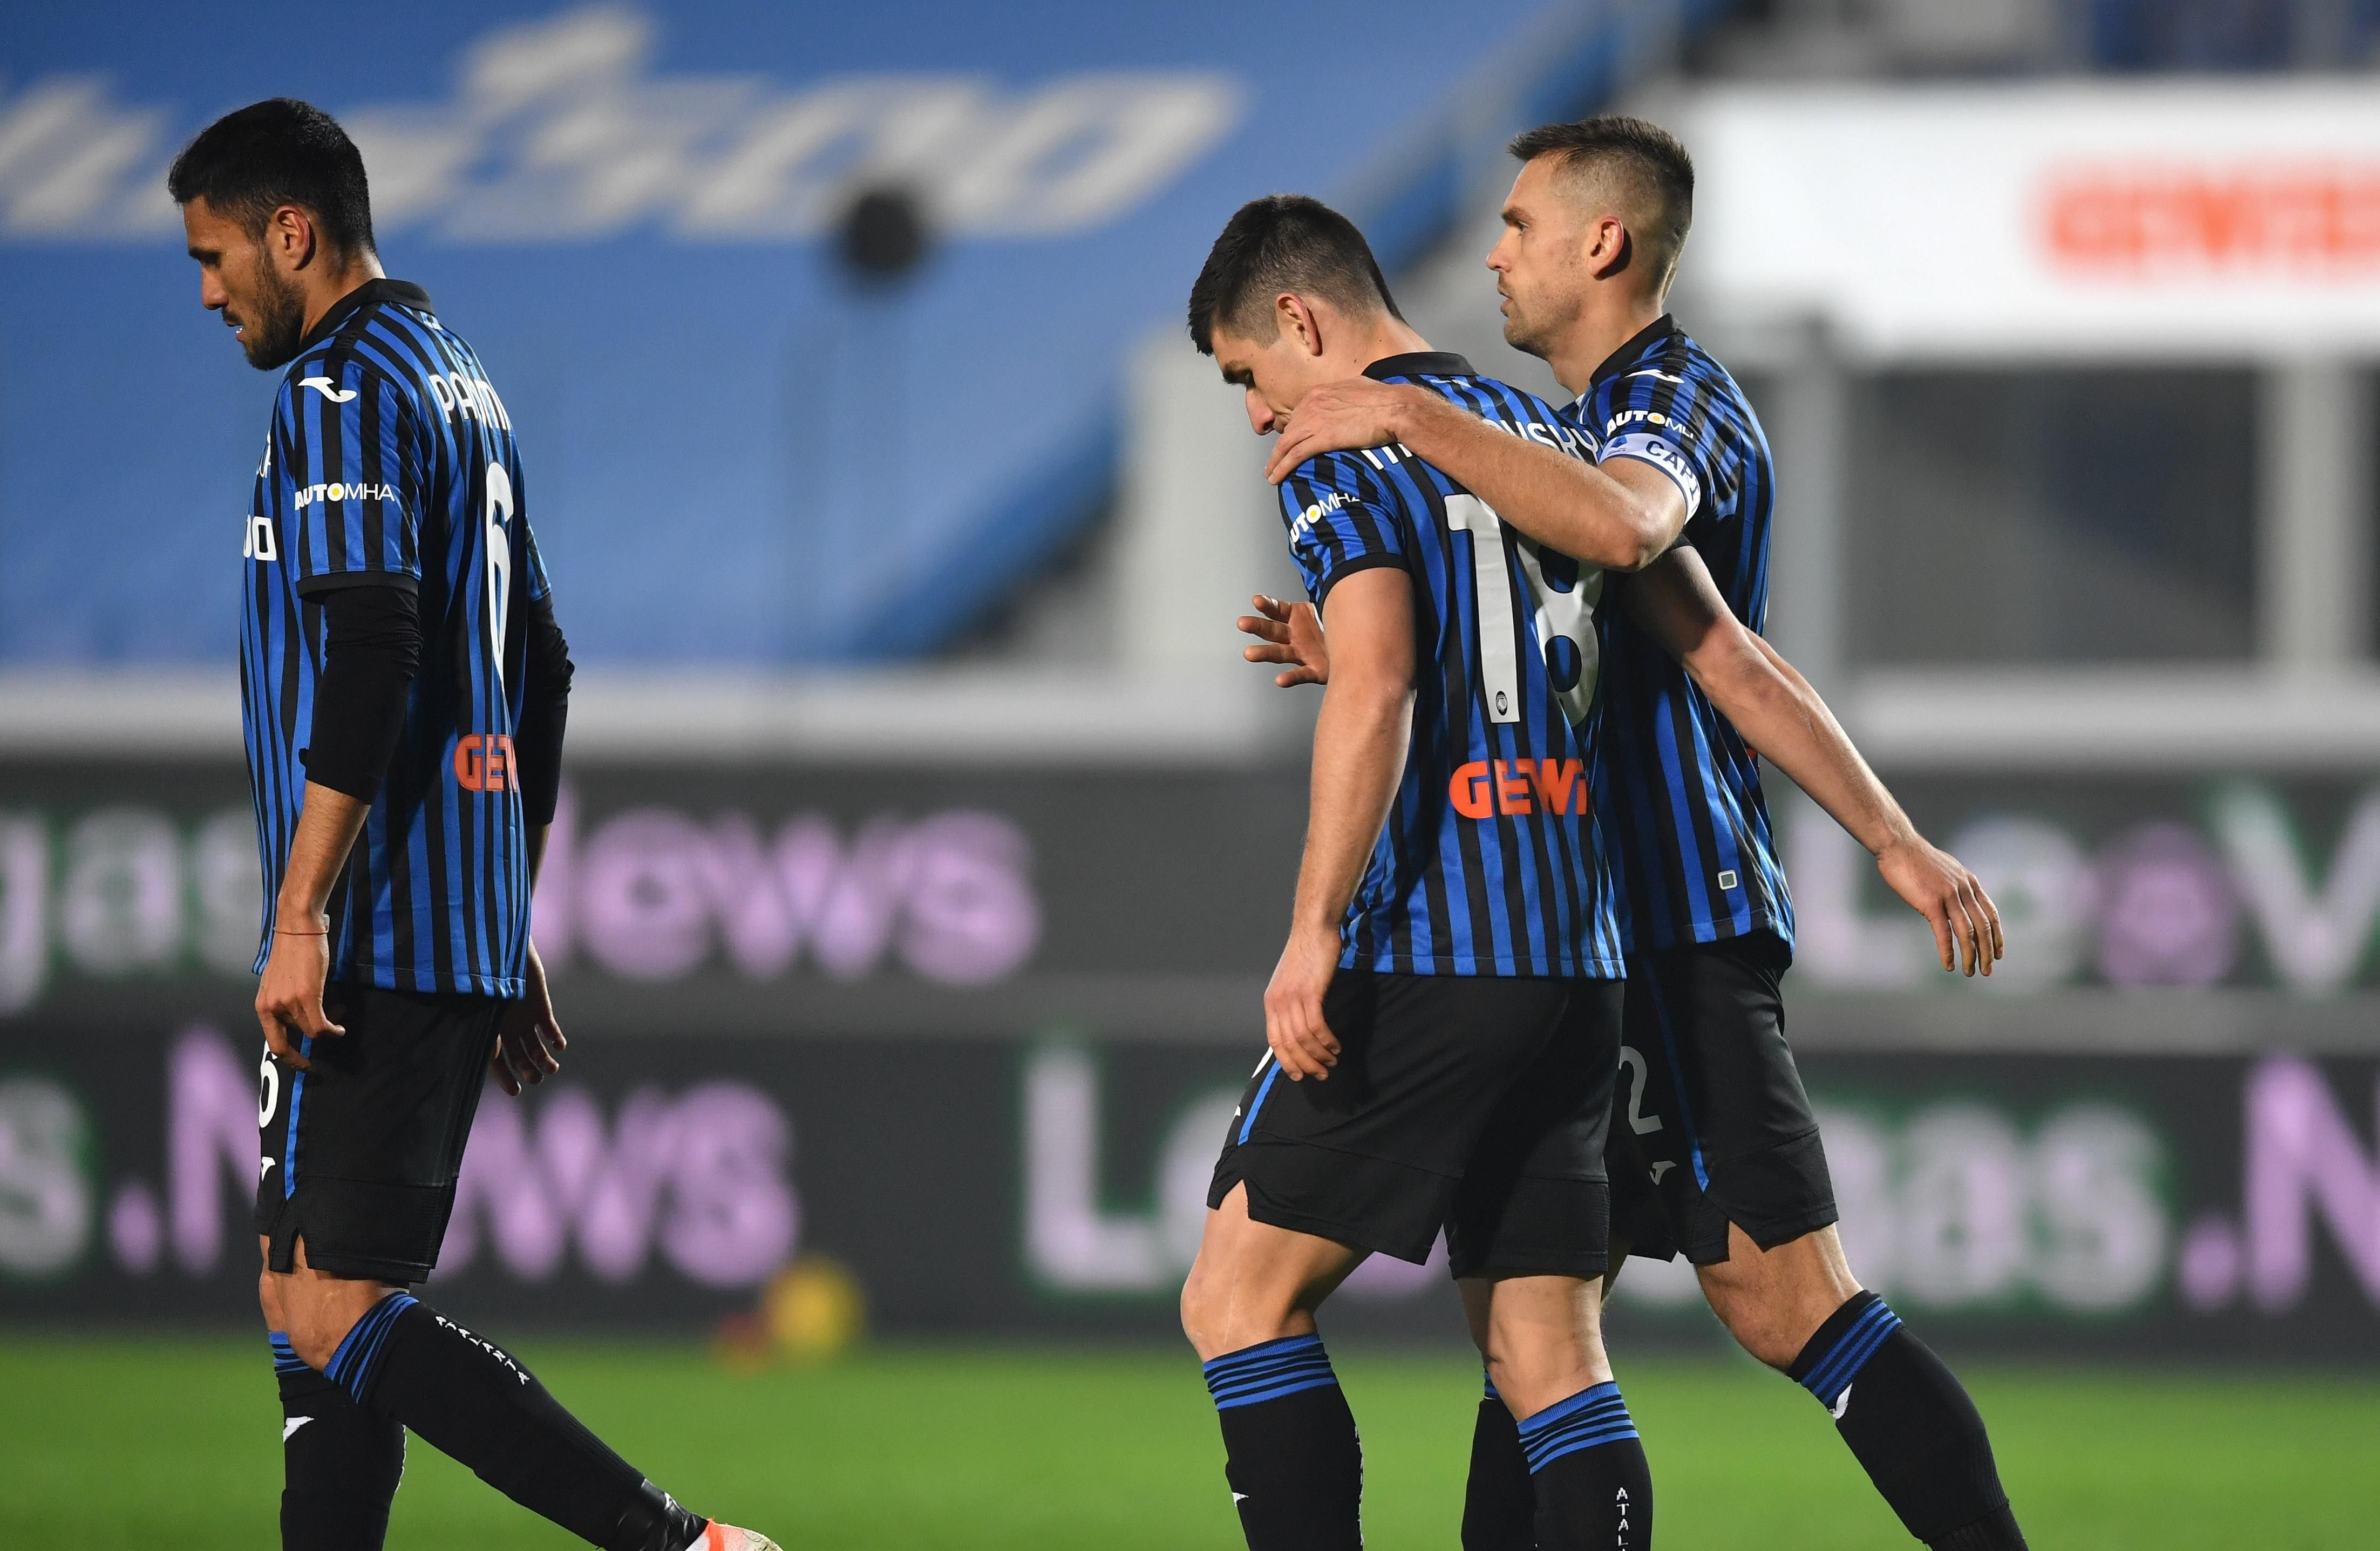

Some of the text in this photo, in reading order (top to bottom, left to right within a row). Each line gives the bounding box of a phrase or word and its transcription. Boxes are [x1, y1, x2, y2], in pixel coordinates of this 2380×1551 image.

[294, 482, 395, 511] AUTOMHA
[486, 461, 514, 693] 6
[1444, 493, 1605, 727] 18
[1619, 1045, 1663, 1135] 2
[1616, 1487, 1630, 1551] ATAL
